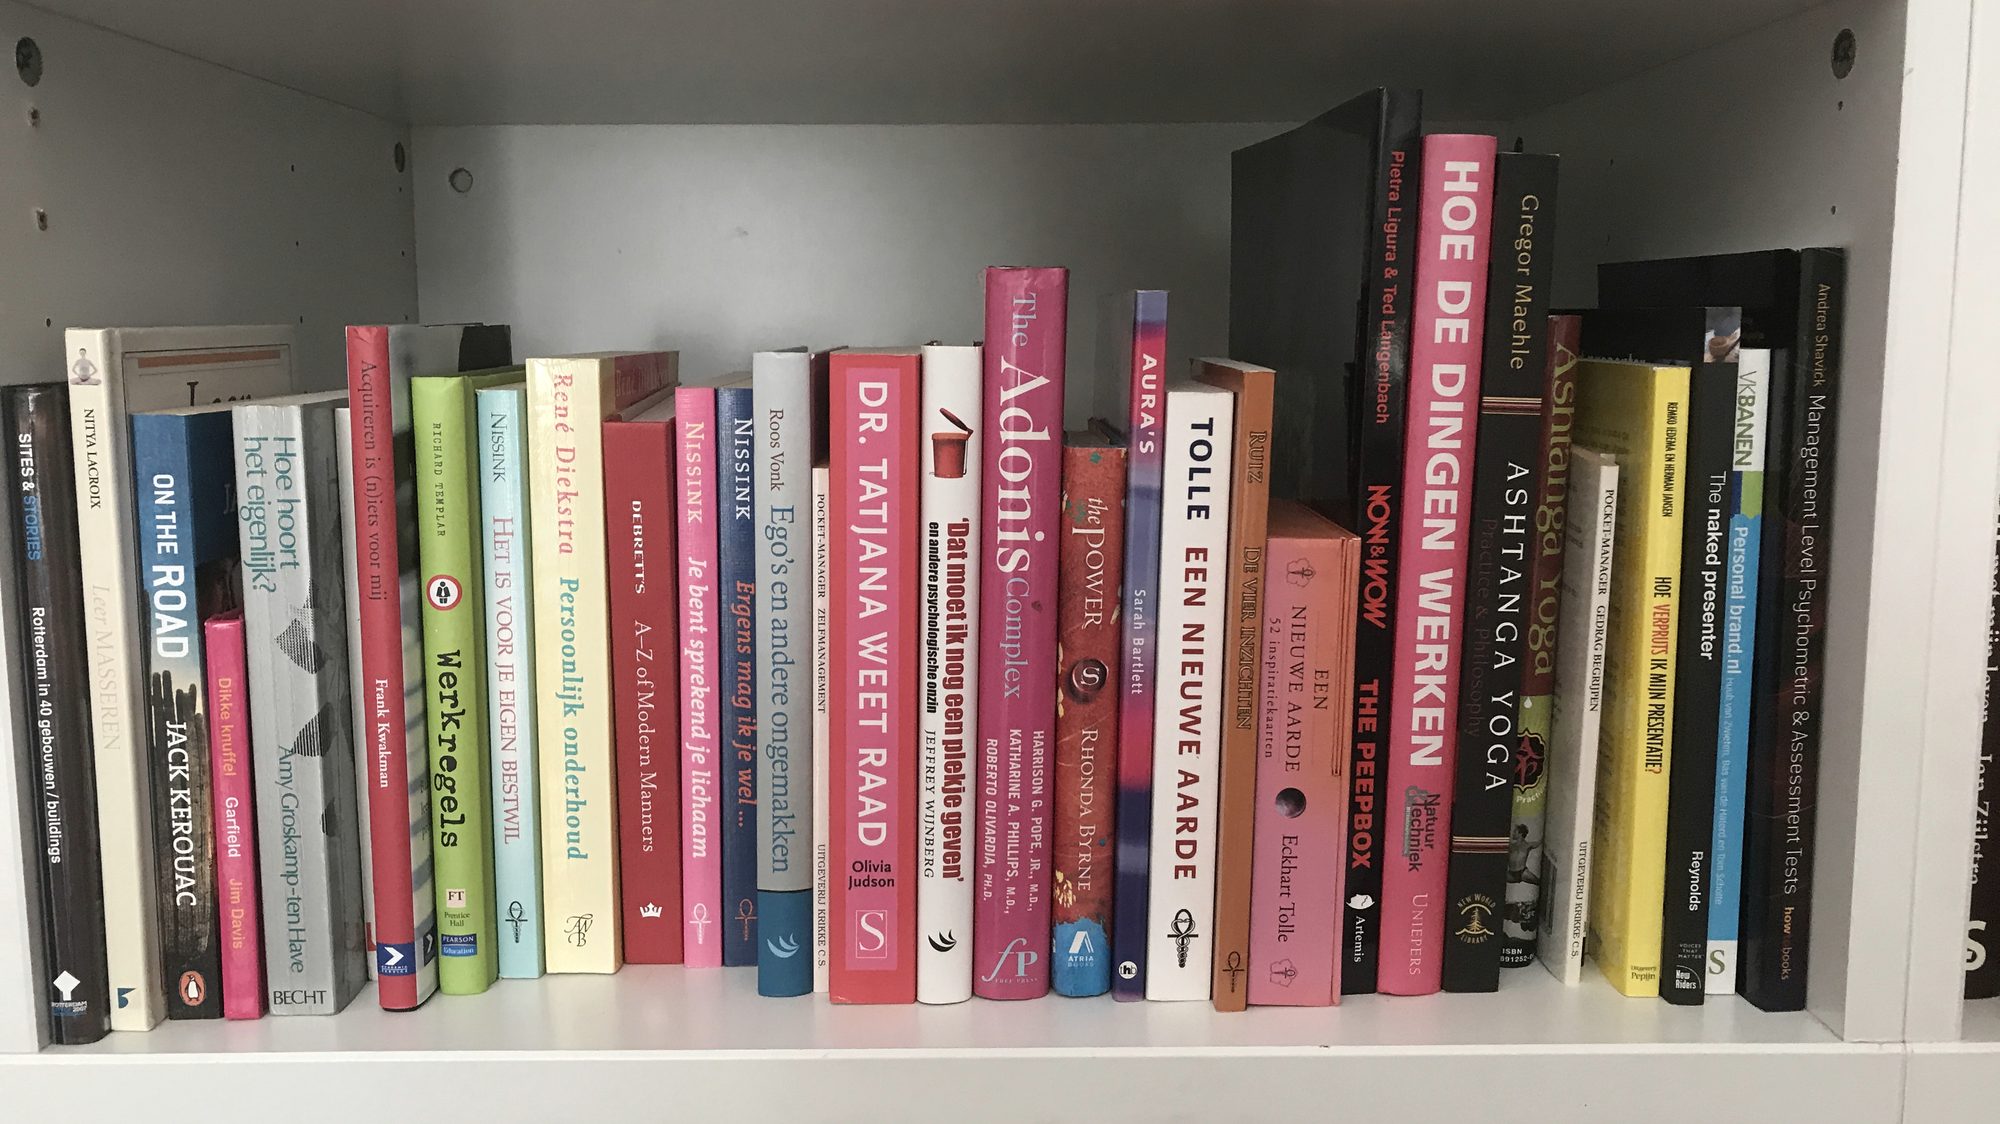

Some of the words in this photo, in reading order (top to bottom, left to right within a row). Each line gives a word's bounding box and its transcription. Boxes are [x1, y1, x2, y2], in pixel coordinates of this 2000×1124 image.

[1388, 151, 1405, 202] Pietra
[1382, 207, 1402, 262] Ligura
[1513, 194, 1540, 275] Gregor
[1510, 285, 1534, 371] Maehle
[1815, 284, 1832, 331] Andrea
[1375, 320, 1394, 425] Langenbach
[1811, 335, 1829, 389] Shavick
[84, 409, 98, 449] NITYA
[358, 360, 379, 450] Acquireren
[1139, 353, 1158, 454] AURA'S
[1666, 402, 1679, 425] REMKO
[1734, 370, 1758, 467] VKBANEN
[19, 434, 35, 478] SITES
[244, 436, 268, 478] het
[273, 437, 297, 491] Hoe
[432, 423, 444, 476] RICHARD
[996, 356, 1051, 573] Adonis
[1187, 418, 1214, 520] TOLLE
[1247, 431, 1267, 484] RUIZ
[1420, 363, 1467, 550] DINGEN
[1664, 427, 1678, 452] IEDEMA
[1801, 395, 1827, 520] Management
[87, 452, 102, 510] LACROIX
[363, 475, 383, 525] (n)iets
[556, 446, 579, 556] Diekstra
[769, 451, 785, 492] Vonk
[1662, 464, 1675, 492] HERMAN
[24, 494, 43, 561] STORIES
[156, 512, 178, 555] THE
[278, 498, 301, 570] hoort
[434, 483, 447, 538] TEMPLAR
[1087, 497, 1109, 525] the
[1661, 493, 1674, 518] JANSEN
[1704, 508, 1722, 566] naked
[240, 485, 277, 594] eigenlijk?
[816, 493, 827, 599] POCKET-MANAGER
[850, 458, 888, 620] TATJANA
[927, 538, 941, 582] andere
[1478, 520, 1499, 601] Practice
[1493, 461, 1530, 671] ASHTANGA
[1597, 490, 1615, 596] POCKET-MANAGER
[1731, 526, 1749, 600] Personal
[1800, 525, 1820, 573] Level
[92, 585, 111, 628] Leer
[152, 565, 190, 659] ROAD
[731, 580, 756, 654] Ergens
[945, 563, 970, 622] moet
[1133, 589, 1147, 631] Sarah
[1240, 578, 1259, 622] VIER
[1700, 571, 1721, 661] presenter
[32, 607, 50, 681] Rotterdam
[555, 577, 585, 718] Persoonlijk
[926, 584, 941, 680] psychologische
[1000, 577, 1030, 699] Complex
[1268, 618, 1281, 635] 52
[1287, 606, 1307, 694] NIEUWE
[1594, 605, 1607, 652] GEDRAG
[1650, 604, 1671, 656] VERPRUTS
[1726, 605, 1744, 675] brand.nl
[1793, 579, 1817, 705] Psychometric
[95, 630, 122, 751] MASSEREN
[684, 639, 711, 739] sprekend
[771, 618, 796, 705] andere
[817, 608, 827, 715] ZELFMANAGEMENT
[858, 631, 888, 734] WEET
[1131, 638, 1145, 696] Bartlett
[1178, 624, 1205, 756] NIEUWE
[1235, 626, 1257, 731] INZICHTEN
[1313, 670, 1330, 711] EEN
[1409, 568, 1454, 767] WERKEN
[1465, 628, 1491, 738] Philosophy
[1589, 653, 1603, 713] BEGRIJPEN
[1648, 673, 1666, 701] MIJN
[218, 678, 235, 720] Dikke
[376, 679, 390, 718] Frank
[499, 690, 518, 753] EIGEN
[637, 690, 658, 767] Modern
[926, 682, 940, 715] onzin
[1262, 641, 1281, 759] inspiratiekaarten
[37, 720, 57, 790] gebouwen
[166, 721, 190, 781] JACK
[221, 725, 238, 777] knuffel
[378, 721, 392, 789] Kwakman
[435, 650, 467, 849] Werkregels
[923, 730, 937, 795] JEFFREY
[985, 739, 998, 796] ROBERTO
[1007, 729, 1021, 800] KATHARINE
[1030, 731, 1045, 792] HARRISON
[1284, 702, 1301, 773] AARDE
[1484, 690, 1514, 792] YOGA
[1644, 703, 1665, 774] PRESENTATIE?
[501, 760, 521, 845] BESTWIL
[564, 727, 588, 860] onderhoud
[738, 768, 757, 805] wel
[766, 711, 796, 874] ongemakken
[858, 748, 888, 847] RAAD
[940, 739, 967, 808] plekje
[1079, 729, 1098, 819] RHONDA
[1784, 731, 1809, 844] Assessment
[46, 801, 63, 865] buildings
[226, 797, 242, 858] Garfield
[639, 772, 658, 852] Manners
[691, 770, 711, 859] lichaam
[982, 800, 998, 868] OLIVARDIA,
[1028, 818, 1043, 855] POPE,
[1174, 769, 1201, 880] AARDE
[1351, 743, 1378, 870] PEEPBOX
[1407, 800, 1428, 873] Techniek
[1423, 794, 1441, 849] Natuur
[170, 788, 197, 907] KEROUAC
[280, 793, 304, 926] Groskamp-ten
[852, 860, 892, 873] Olivia
[923, 800, 936, 879] WIJNBERG
[1004, 822, 1019, 882] PHILLIPS,
[1028, 858, 1041, 880] JR.,
[1077, 824, 1096, 892] BYRNE
[1278, 835, 1299, 898] Eckhart
[1576, 841, 1588, 901] UITGEVERIJ
[449, 891, 465, 901] FT
[817, 844, 827, 905] UITGEVERIJ
[848, 876, 896, 892] Judson
[982, 874, 993, 902] PH.D.
[1004, 887, 1015, 915] M.D.,
[1026, 884, 1039, 912] M.D.,
[1687, 851, 1704, 912] Reynolds
[1782, 848, 1803, 896] Tests
[230, 908, 246, 950] Davis
[288, 928, 307, 973] Have
[817, 908, 827, 947] KRIKKE
[1276, 902, 1296, 943] Tolle
[1353, 916, 1368, 964] Artemis
[1573, 902, 1583, 940] KRIKKE
[817, 949, 827, 969] C.S.
[273, 990, 327, 1005] BECHT
